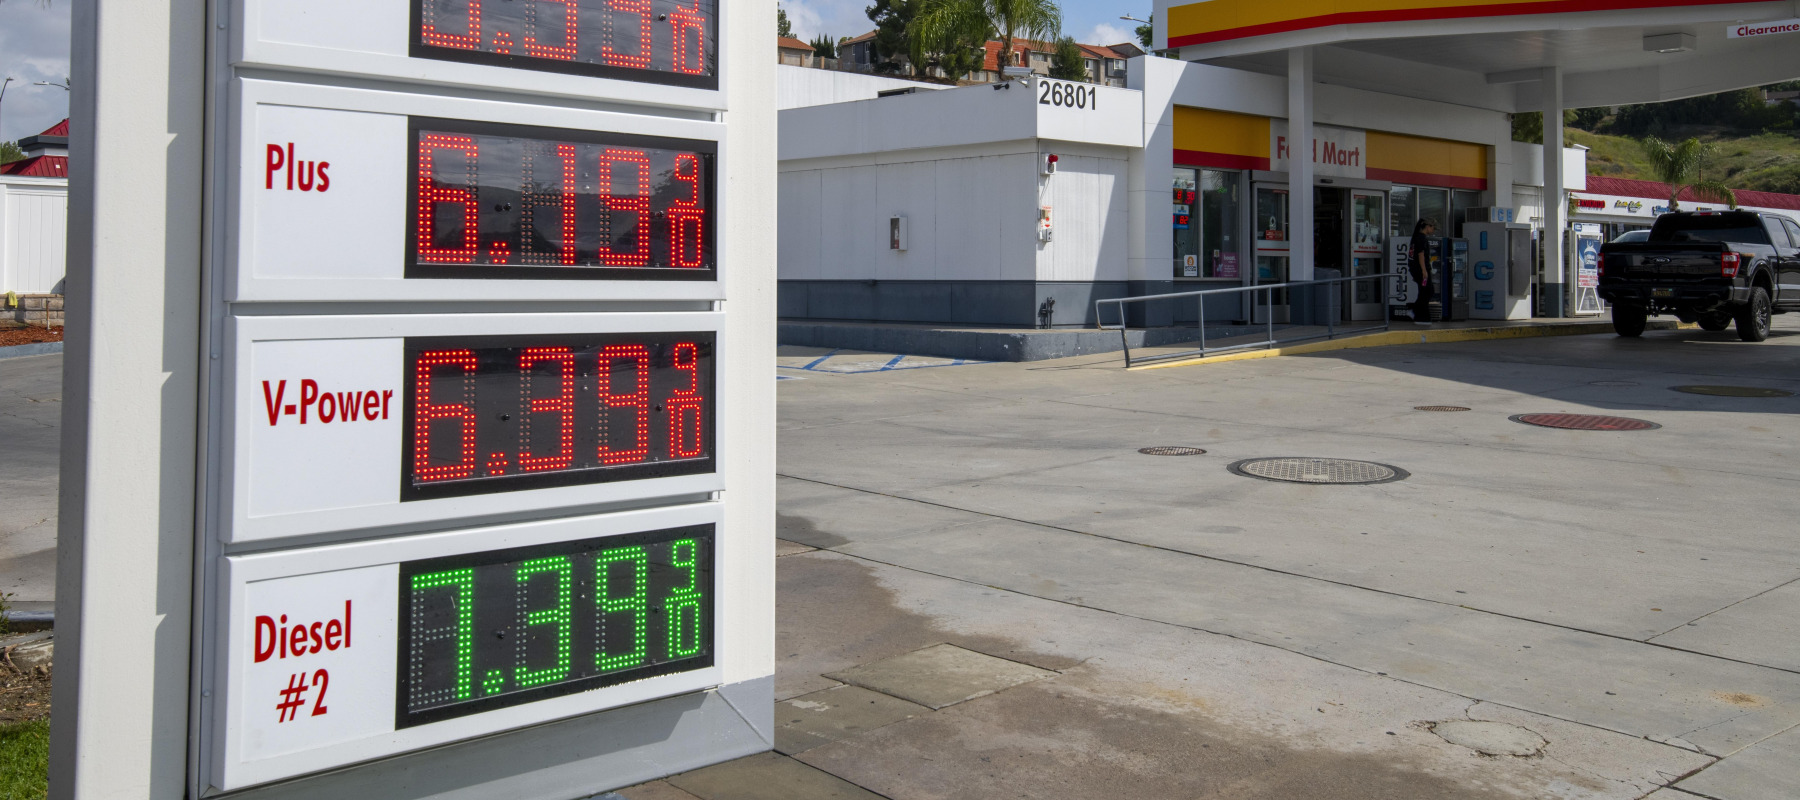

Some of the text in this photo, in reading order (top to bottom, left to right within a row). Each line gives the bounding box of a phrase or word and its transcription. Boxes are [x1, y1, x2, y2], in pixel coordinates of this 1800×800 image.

[1737, 23, 1800, 37] Clearance
[1038, 79, 1097, 111] 26801
[265, 142, 331, 193] Plus
[1322, 141, 1360, 167] Mart
[417, 133, 650, 267] 6.19
[1491, 207, 1514, 223] ICE
[261, 378, 393, 427] V-Power
[414, 344, 650, 481] 6.39
[253, 599, 352, 665] Diesel
[410, 545, 647, 700] 7.39
[276, 668, 329, 723] #2
